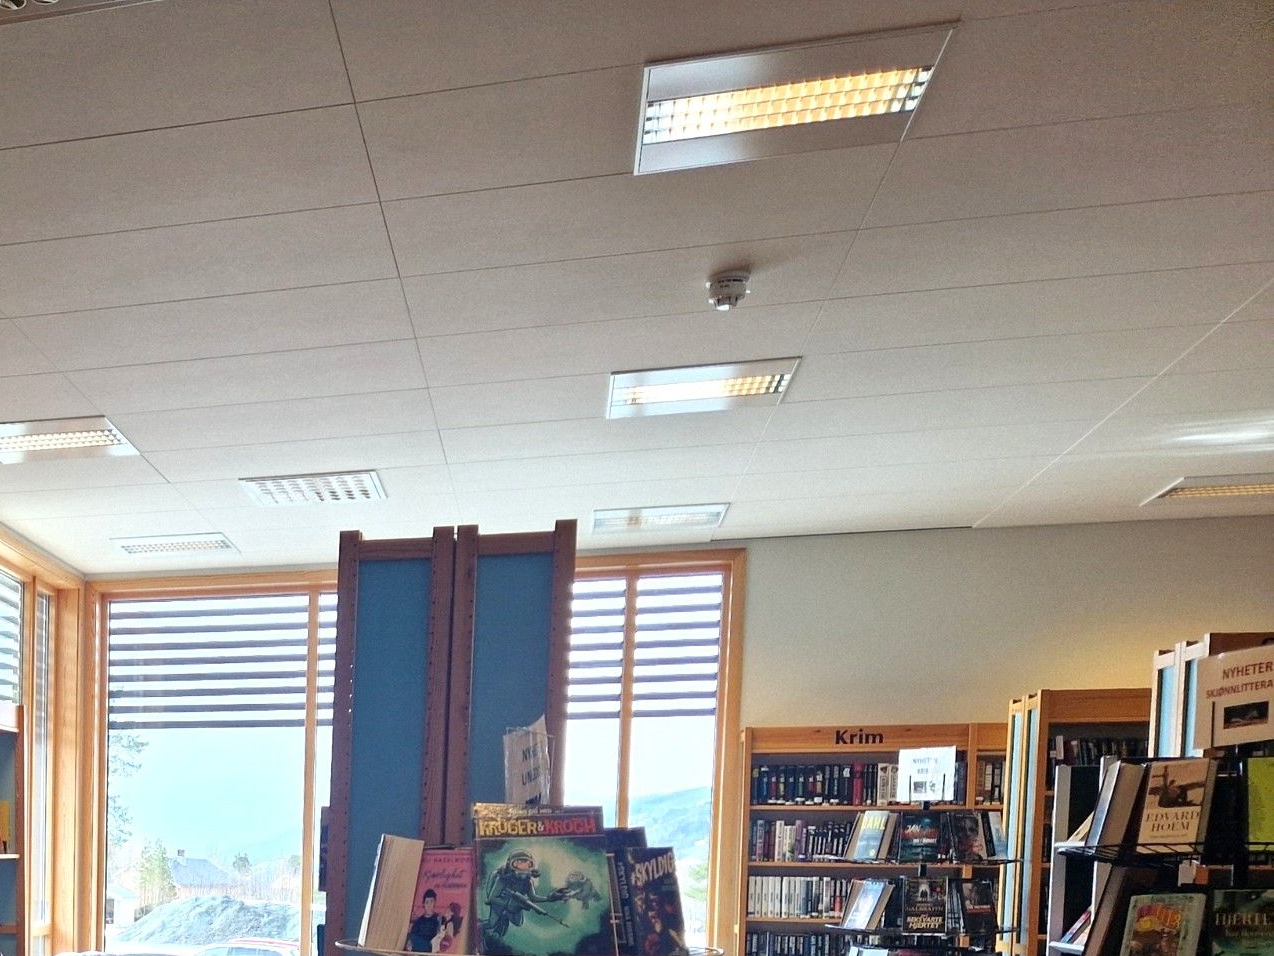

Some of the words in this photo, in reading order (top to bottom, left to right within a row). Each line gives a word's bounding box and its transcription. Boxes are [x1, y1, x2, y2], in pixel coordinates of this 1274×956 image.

[1222, 661, 1273, 680] NYHETER
[835, 728, 884, 745] Krim
[1146, 810, 1200, 822] EDVARD
